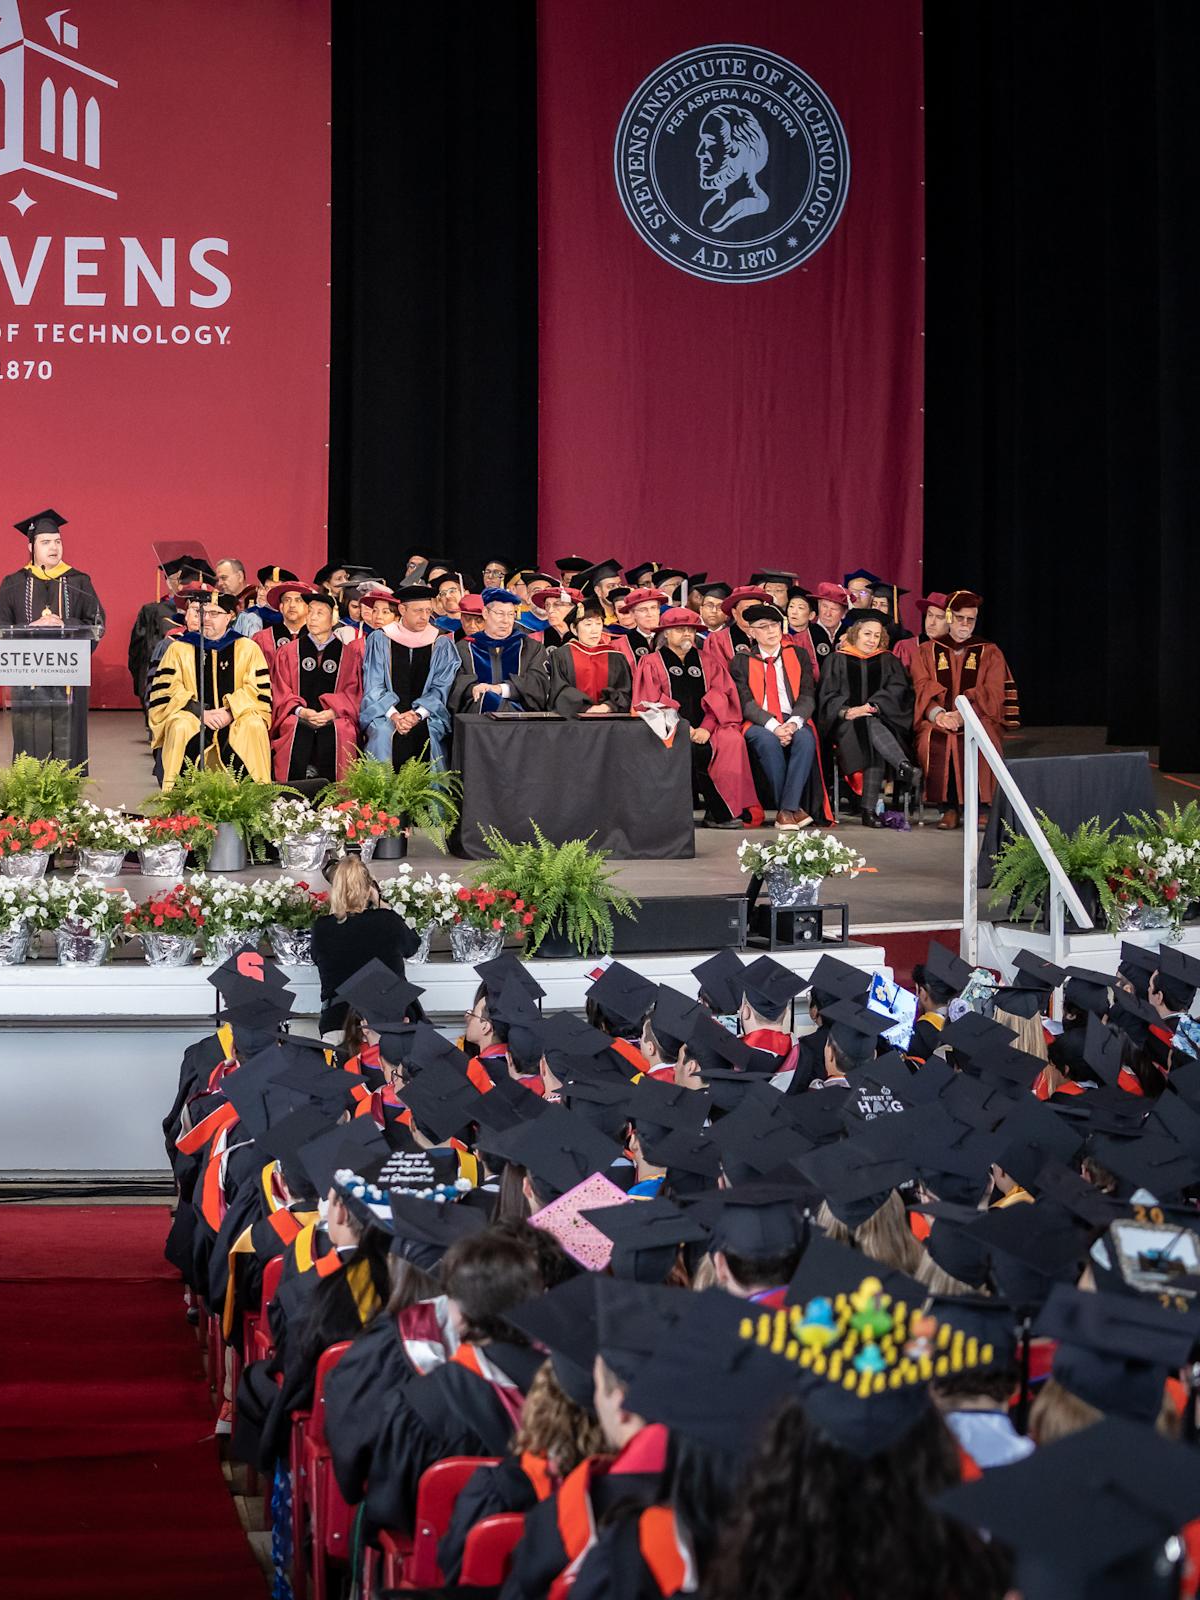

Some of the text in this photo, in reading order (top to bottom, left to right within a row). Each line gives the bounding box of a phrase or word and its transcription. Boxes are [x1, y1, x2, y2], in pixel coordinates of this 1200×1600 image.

[666, 88, 798, 139] PER ASPERA AD ASTRA
[629, 58, 836, 234] STEVENS INSTITUTE OF TECHNOLOGY
[691, 246, 777, 270] A.D. 1870
[0, 652, 78, 666] STEVENS
